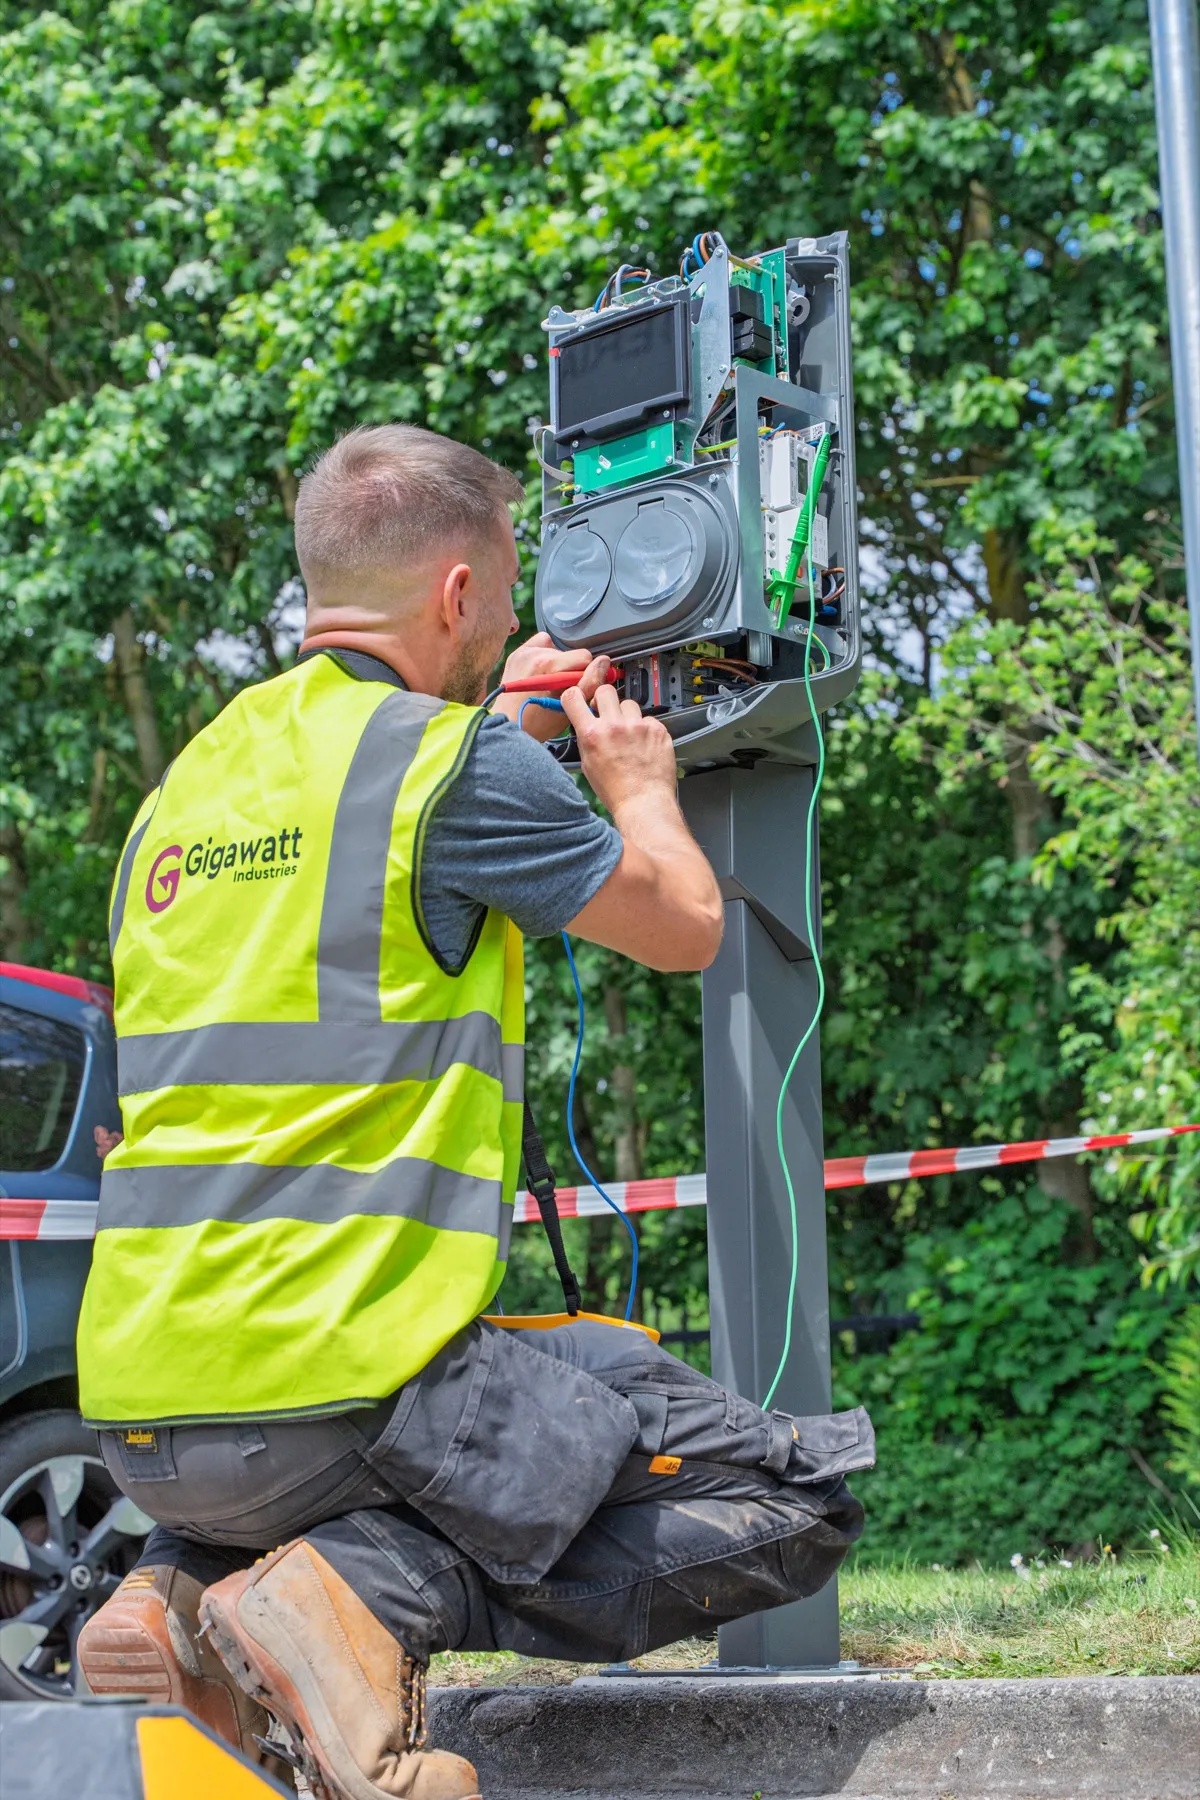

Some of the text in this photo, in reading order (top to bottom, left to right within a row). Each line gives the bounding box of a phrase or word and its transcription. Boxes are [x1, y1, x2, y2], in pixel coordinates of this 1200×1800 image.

[185, 827, 302, 880] Gigawatt
[233, 863, 297, 883] Industries
[665, 1462, 678, 1472] 46
